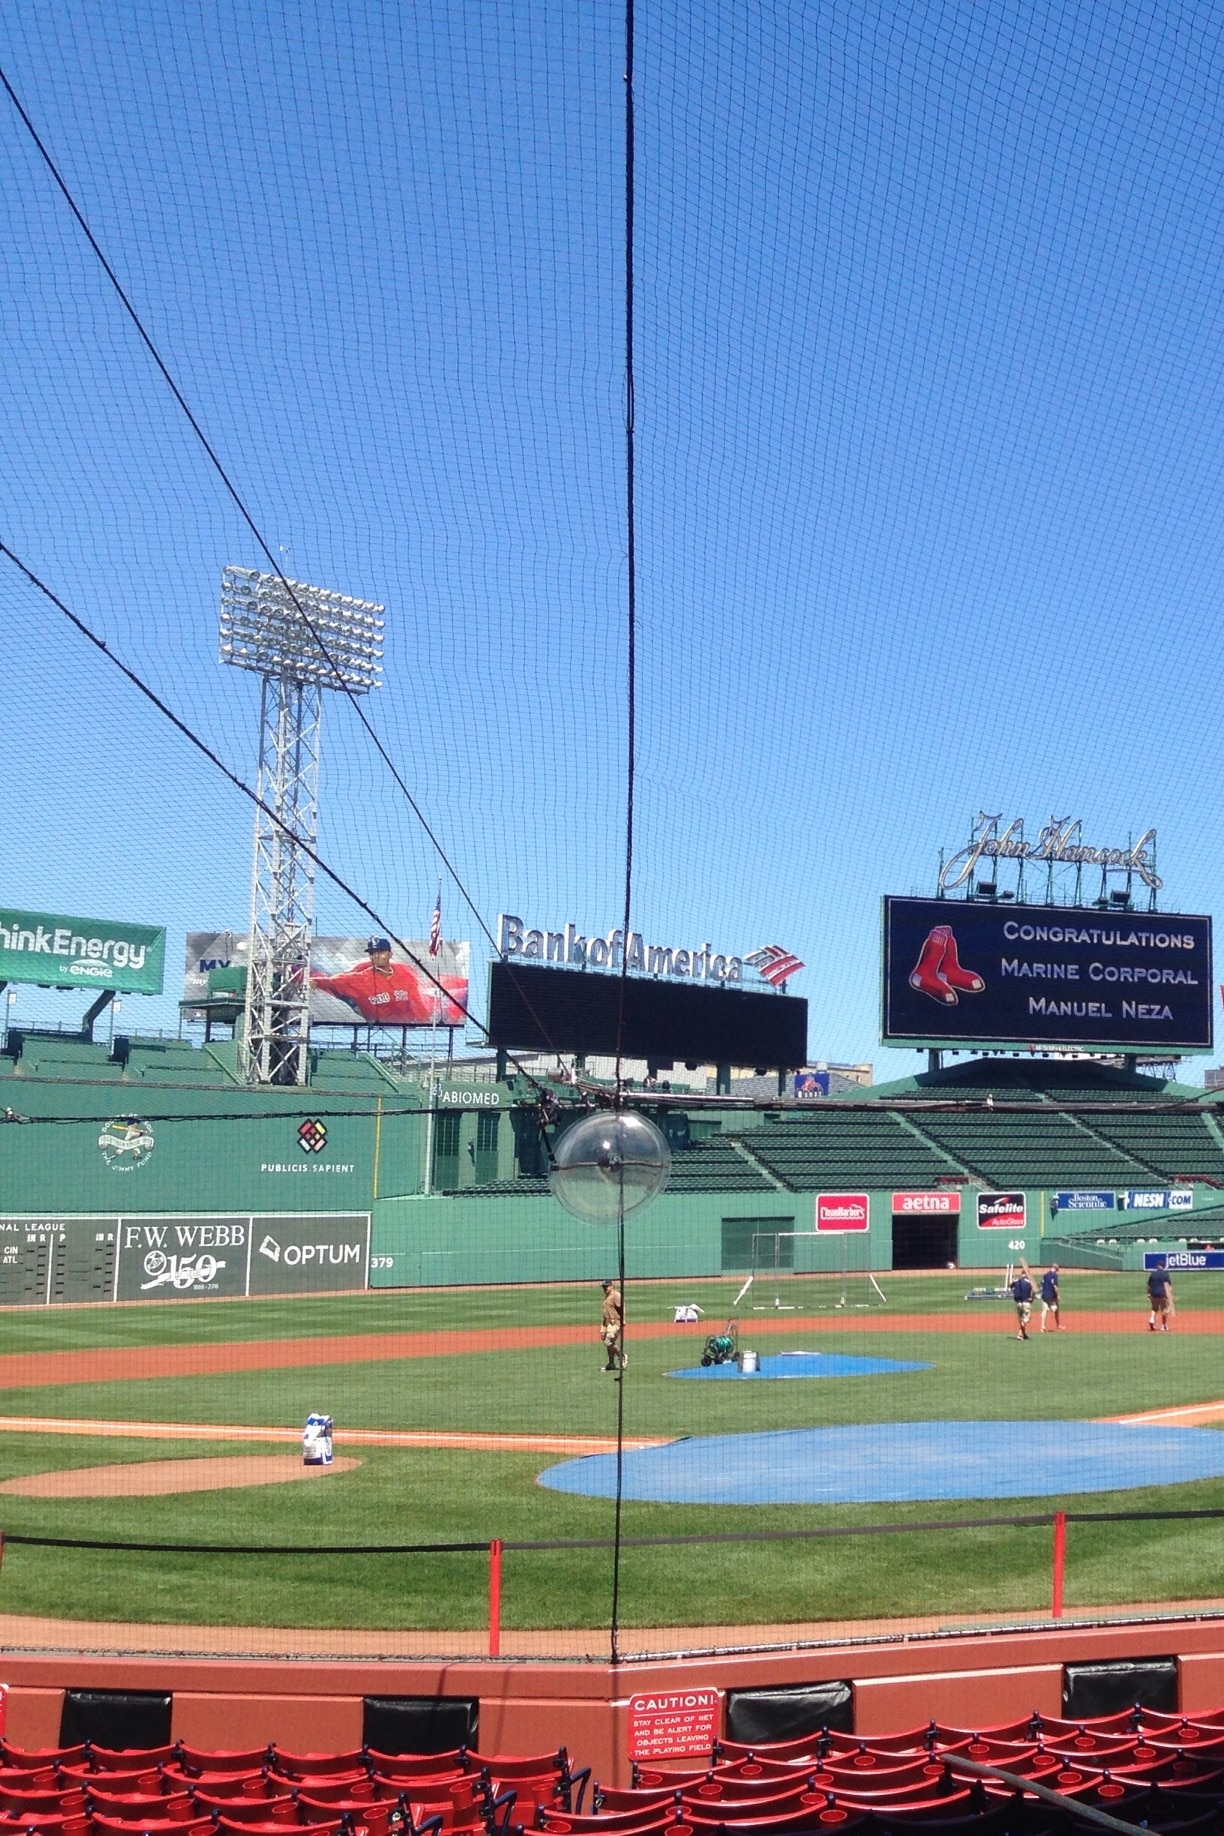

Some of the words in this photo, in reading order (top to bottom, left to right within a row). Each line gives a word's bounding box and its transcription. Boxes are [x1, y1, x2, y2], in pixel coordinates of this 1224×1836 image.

[938, 810, 1031, 890] John
[1029, 815, 1163, 889] Hancock
[442, 1091, 500, 1105] ABIOMED
[903, 1195, 950, 1210] aetna
[979, 1203, 1024, 1214] Safelite
[24, 1223, 66, 1232] LEAGUE
[40, 1234, 46, 1242] R
[60, 1233, 66, 1242] P
[107, 1233, 114, 1241] R
[124, 1226, 168, 1249] F.W.
[174, 1225, 245, 1247] WEBB
[4, 1246, 18, 1255] CIN
[1008, 1240, 1026, 1250] 420
[3, 1255, 18, 1264] ATL
[283, 1244, 361, 1266] OPTUM
[1165, 1253, 1208, 1268] jetBlue
[370, 1257, 394, 1268] 379
[634, 1695, 714, 1711] CAUTION!
[633, 1719, 651, 1727] STAY
[655, 1717, 681, 1725] CLEAR
[667, 1725, 692, 1733] ALERT
[637, 1737, 673, 1746] OBJECTS
[676, 1734, 709, 1743] LEAVING
[653, 1745, 686, 1754] PLAYING
[689, 1743, 711, 1751] FIELD
